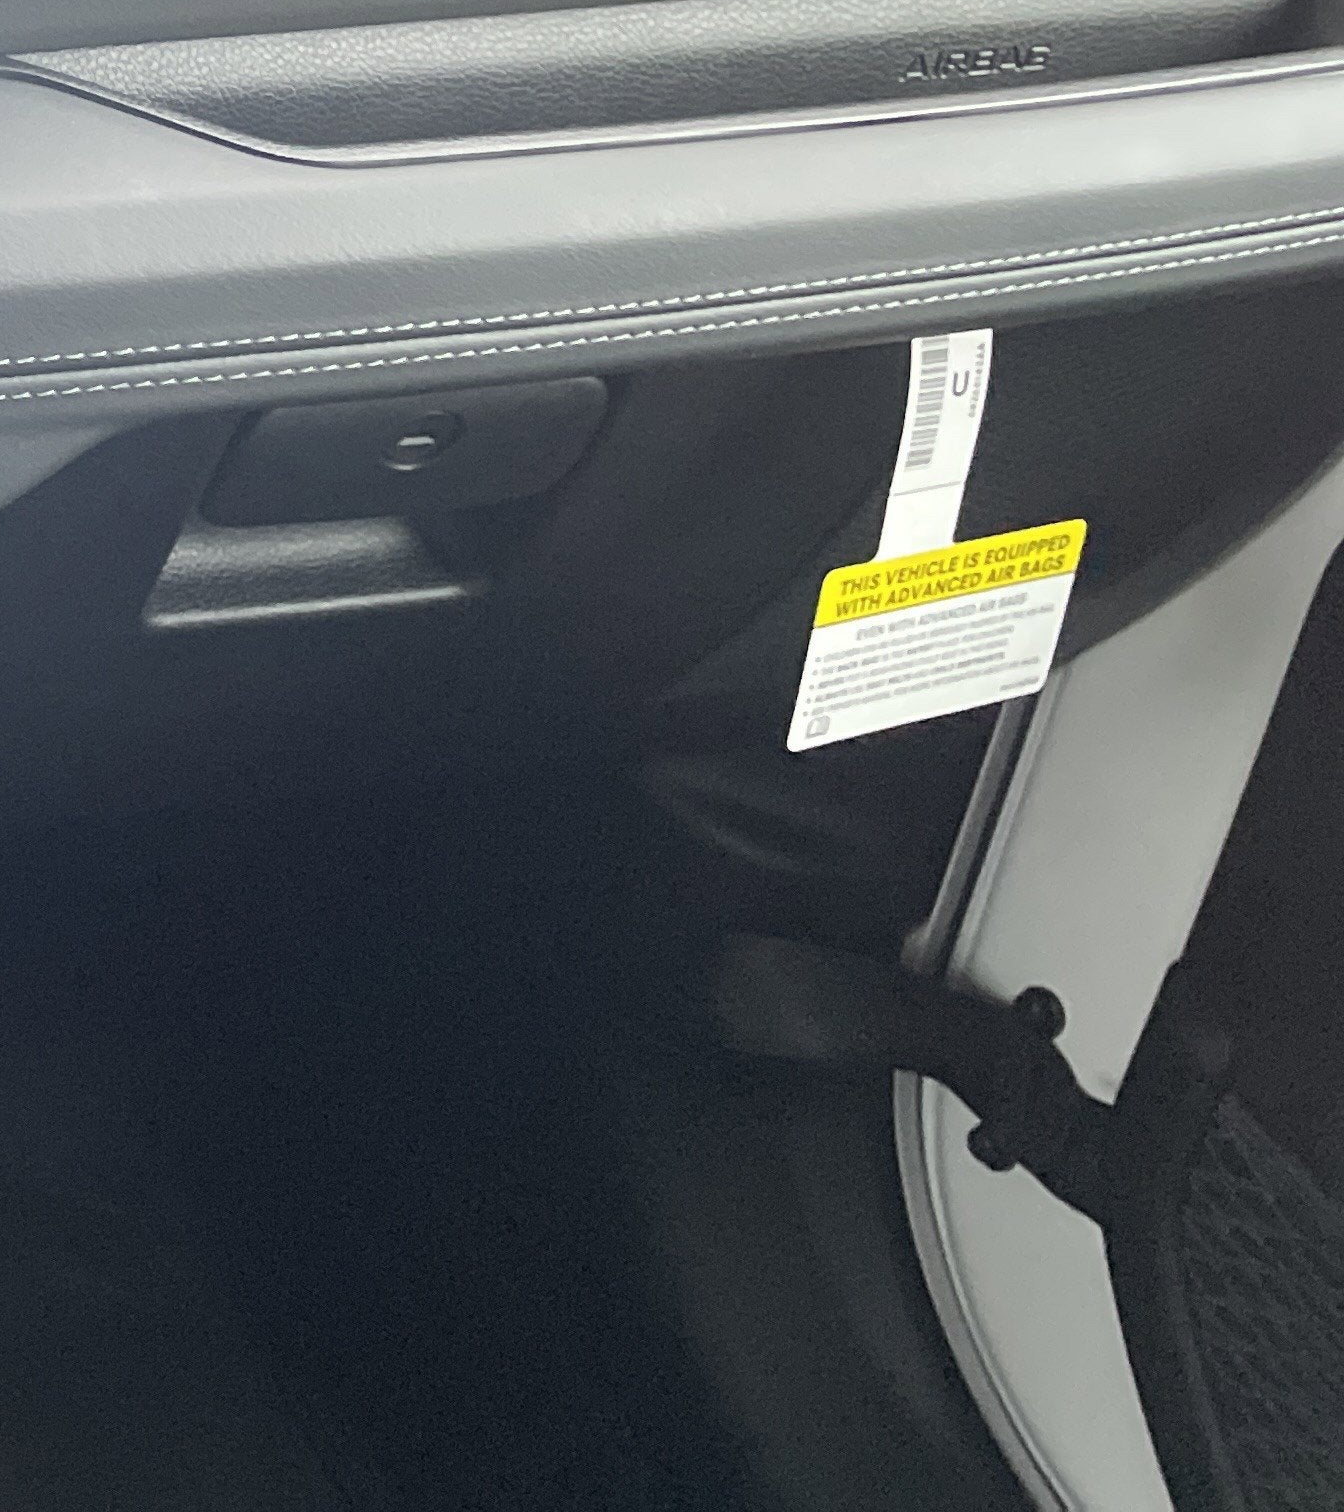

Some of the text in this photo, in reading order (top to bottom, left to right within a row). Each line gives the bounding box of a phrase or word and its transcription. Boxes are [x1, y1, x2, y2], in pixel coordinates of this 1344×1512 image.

[898, 46, 1051, 83] AIRBAG
[836, 595, 881, 618] WITH
[884, 572, 983, 605] ADVANCED
[986, 567, 1016, 584] AIR
[1019, 554, 1067, 578] BAGS
[840, 534, 1071, 596] THIS VEHICLE IS EQUIPPED
